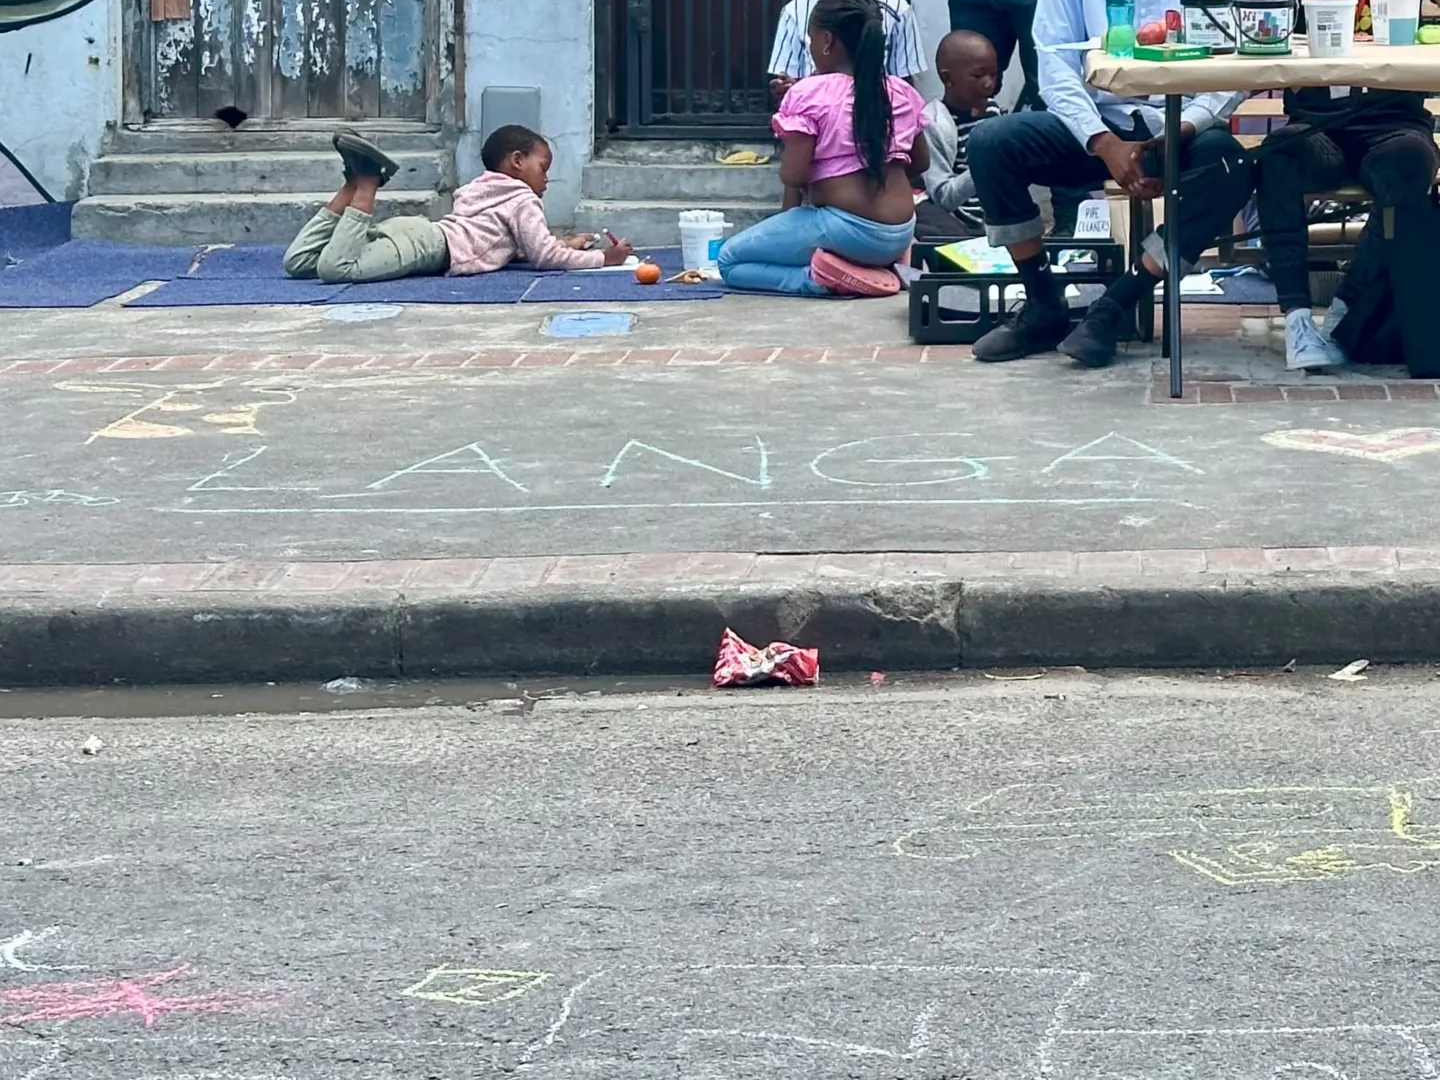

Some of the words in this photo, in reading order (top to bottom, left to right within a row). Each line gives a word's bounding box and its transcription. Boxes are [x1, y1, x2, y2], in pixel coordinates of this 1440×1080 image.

[1085, 207, 1100, 220] PIPE
[1077, 220, 1110, 233] CLEANERS
[187, 431, 1206, 493] LANGA
